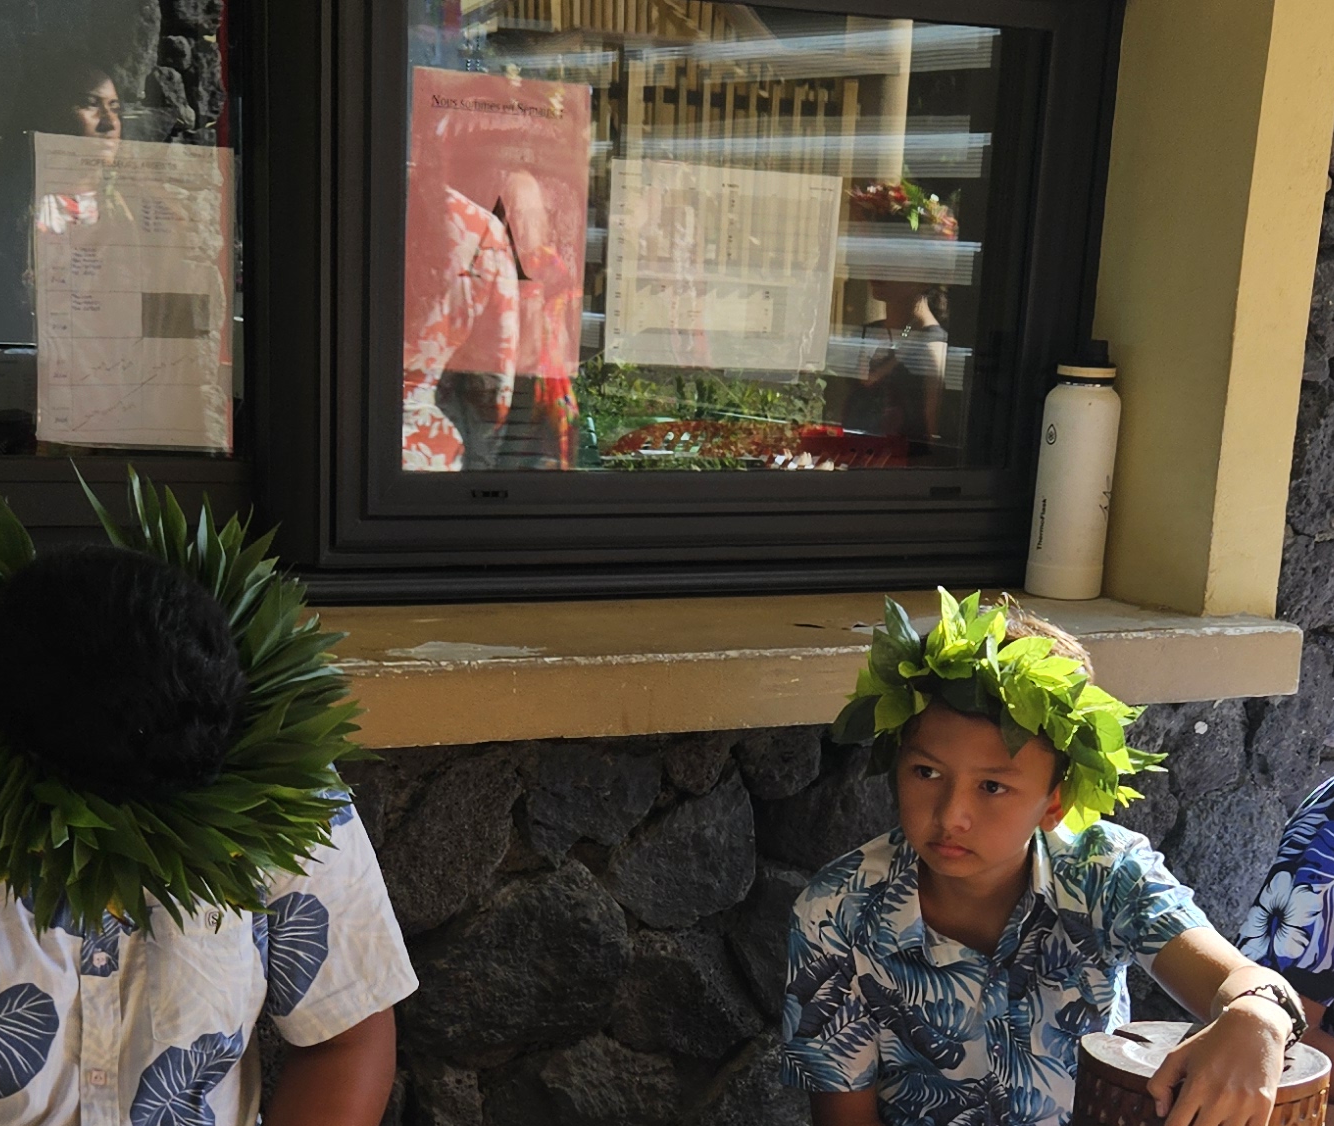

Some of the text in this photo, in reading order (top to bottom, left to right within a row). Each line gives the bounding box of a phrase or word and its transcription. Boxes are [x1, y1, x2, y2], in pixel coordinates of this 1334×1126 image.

[431, 94, 457, 107] Nous
[460, 97, 500, 111] sommes
[457, 194, 534, 282] A
